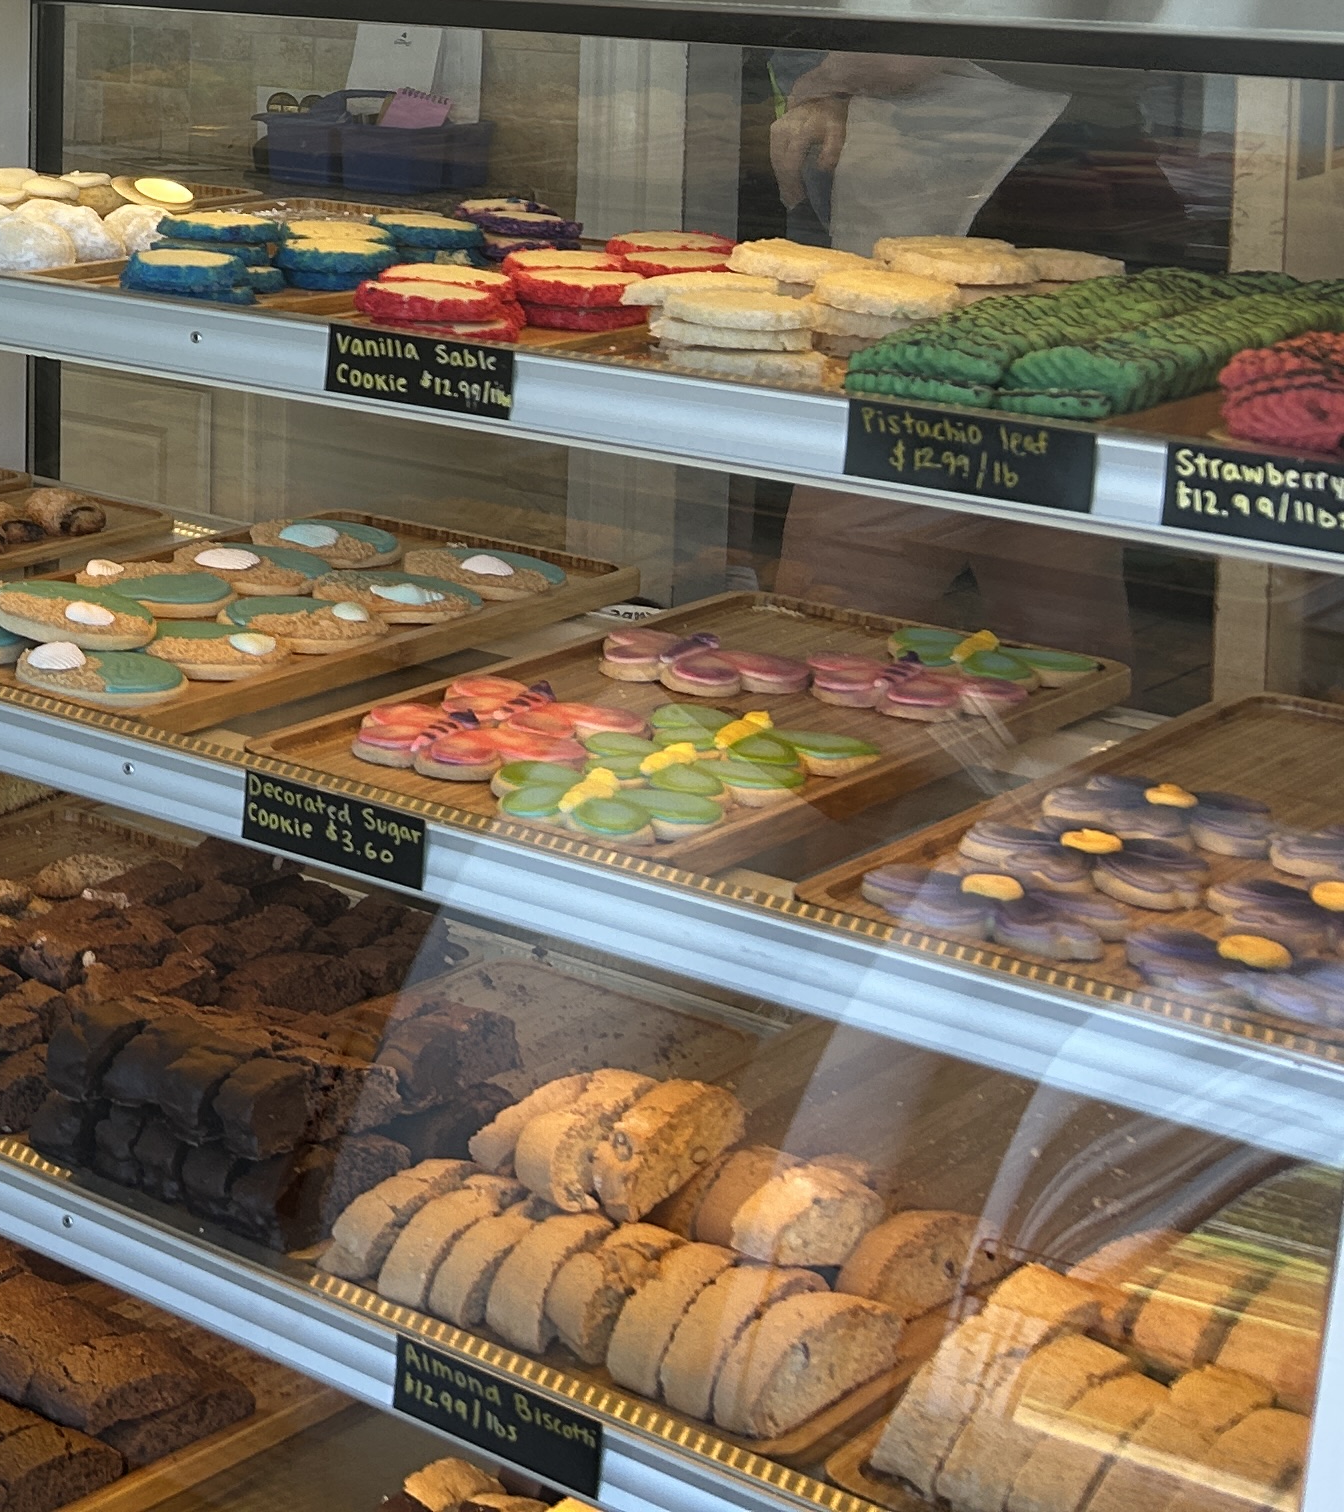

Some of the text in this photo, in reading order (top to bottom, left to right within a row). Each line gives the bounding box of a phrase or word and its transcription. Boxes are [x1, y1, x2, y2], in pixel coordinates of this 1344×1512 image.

[335, 332, 498, 371] Vanilla Sable
[336, 362, 409, 393] Cookie
[861, 406, 983, 445] Pistachio
[248, 774, 423, 845] Decorated Sugar
[325, 819, 395, 864] $3.60
[404, 1342, 598, 1449] Almond Biscotti
